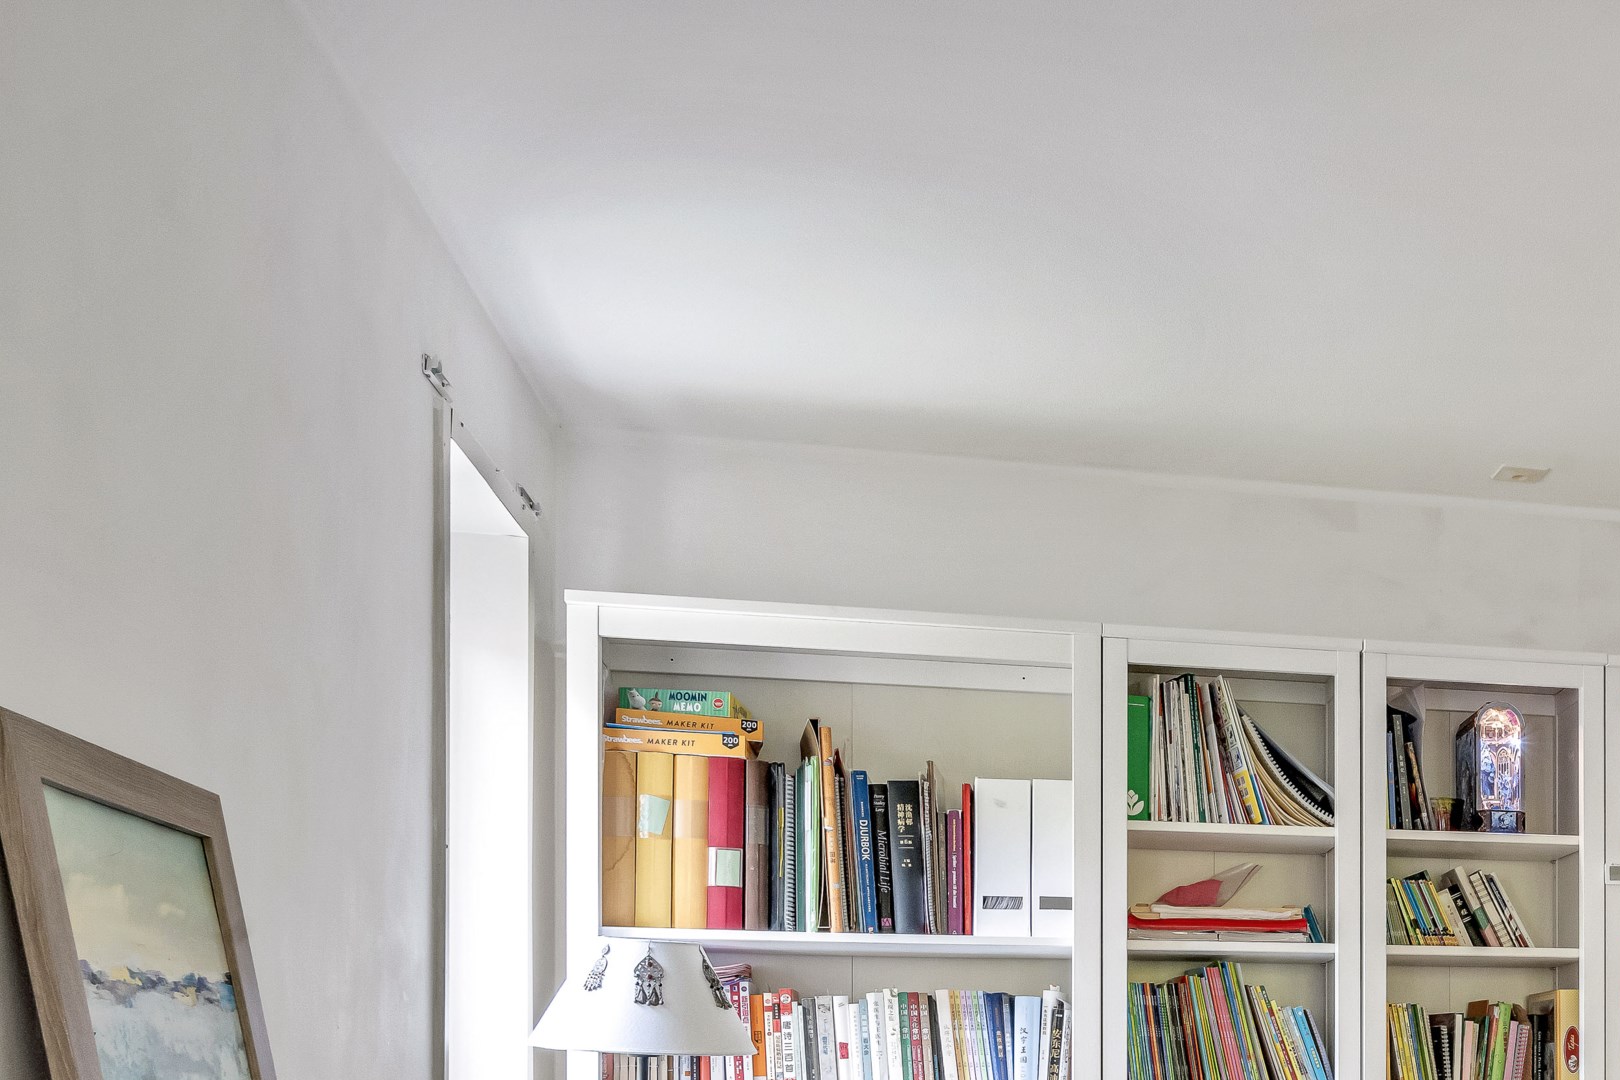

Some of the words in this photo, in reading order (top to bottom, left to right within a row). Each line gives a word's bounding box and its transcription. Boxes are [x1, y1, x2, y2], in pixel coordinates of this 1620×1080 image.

[668, 691, 707, 702] MOOMIN
[673, 701, 702, 712] MEMO
[666, 720, 697, 729] MAKER
[700, 721, 715, 730] KIT
[741, 720, 757, 729] 200
[647, 738, 678, 746] MAKER
[681, 739, 696, 747] KIT
[722, 736, 739, 744] 200
[876, 829, 889, 873] Microbial
[879, 875, 891, 894] Life
